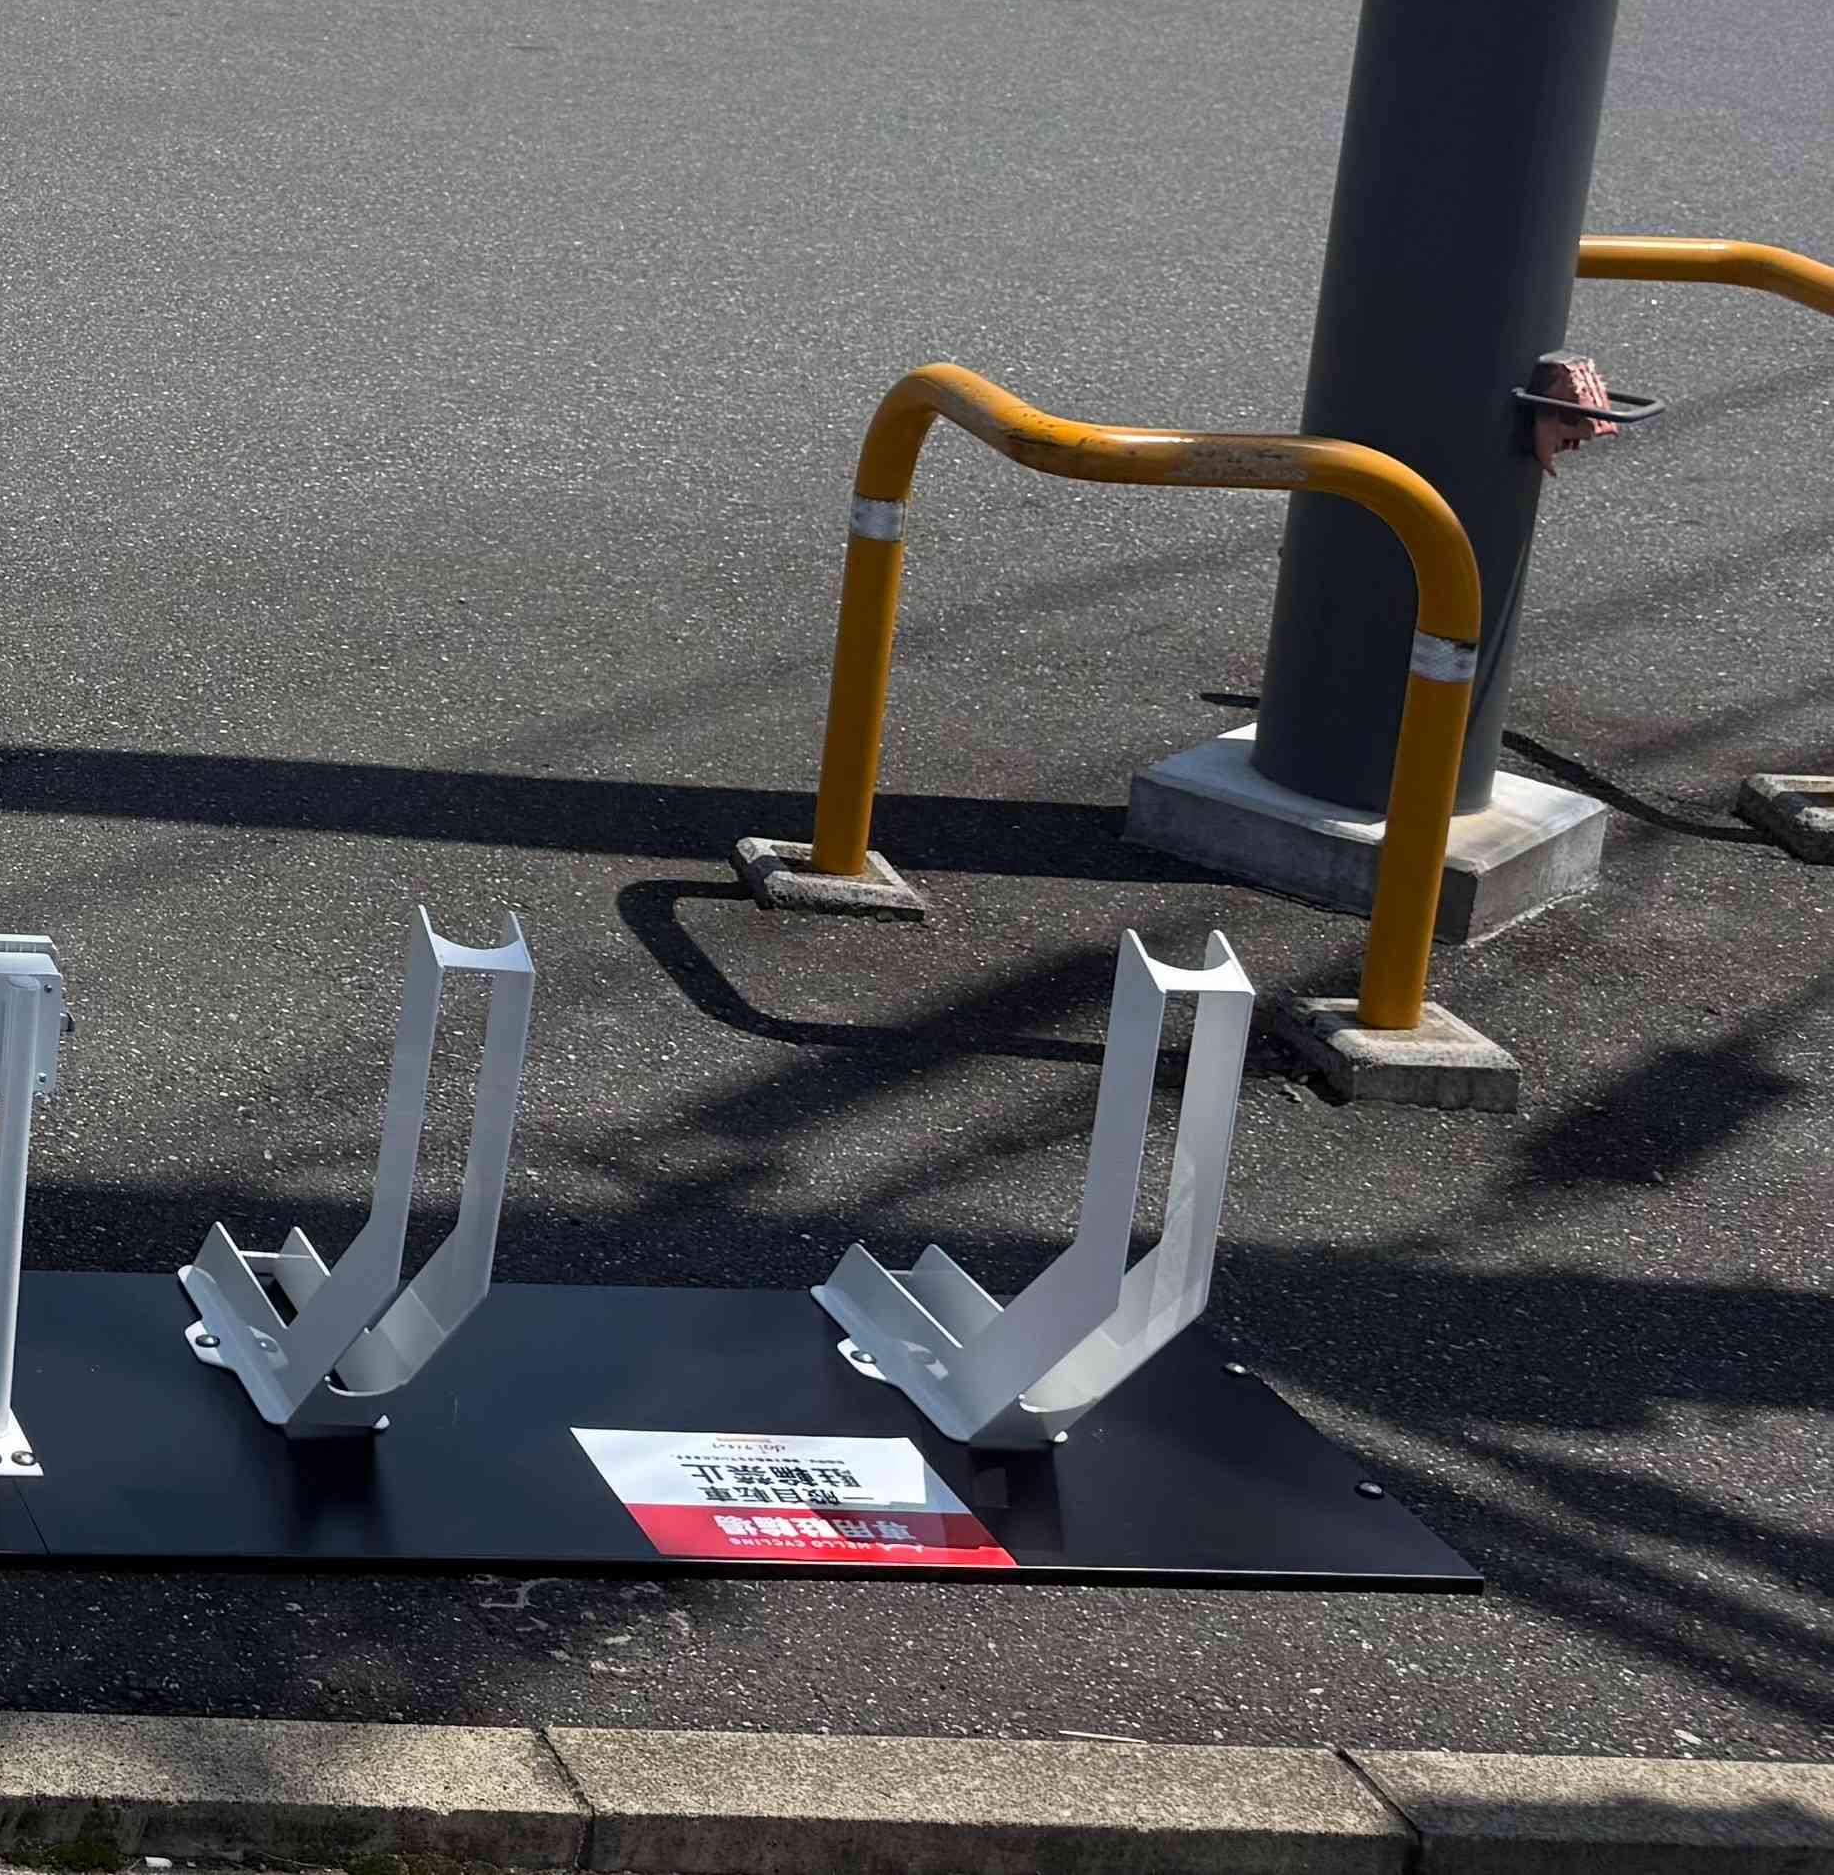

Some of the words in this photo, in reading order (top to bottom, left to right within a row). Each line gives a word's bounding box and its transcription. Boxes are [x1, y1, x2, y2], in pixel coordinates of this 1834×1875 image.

[680, 1463, 862, 1488] 駐輪禁止
[696, 1485, 875, 1506] 一般自転車
[712, 1514, 917, 1541] 専用駐輪場
[727, 1537, 806, 1548] CYCLING
[810, 1539, 872, 1550] HELLO
